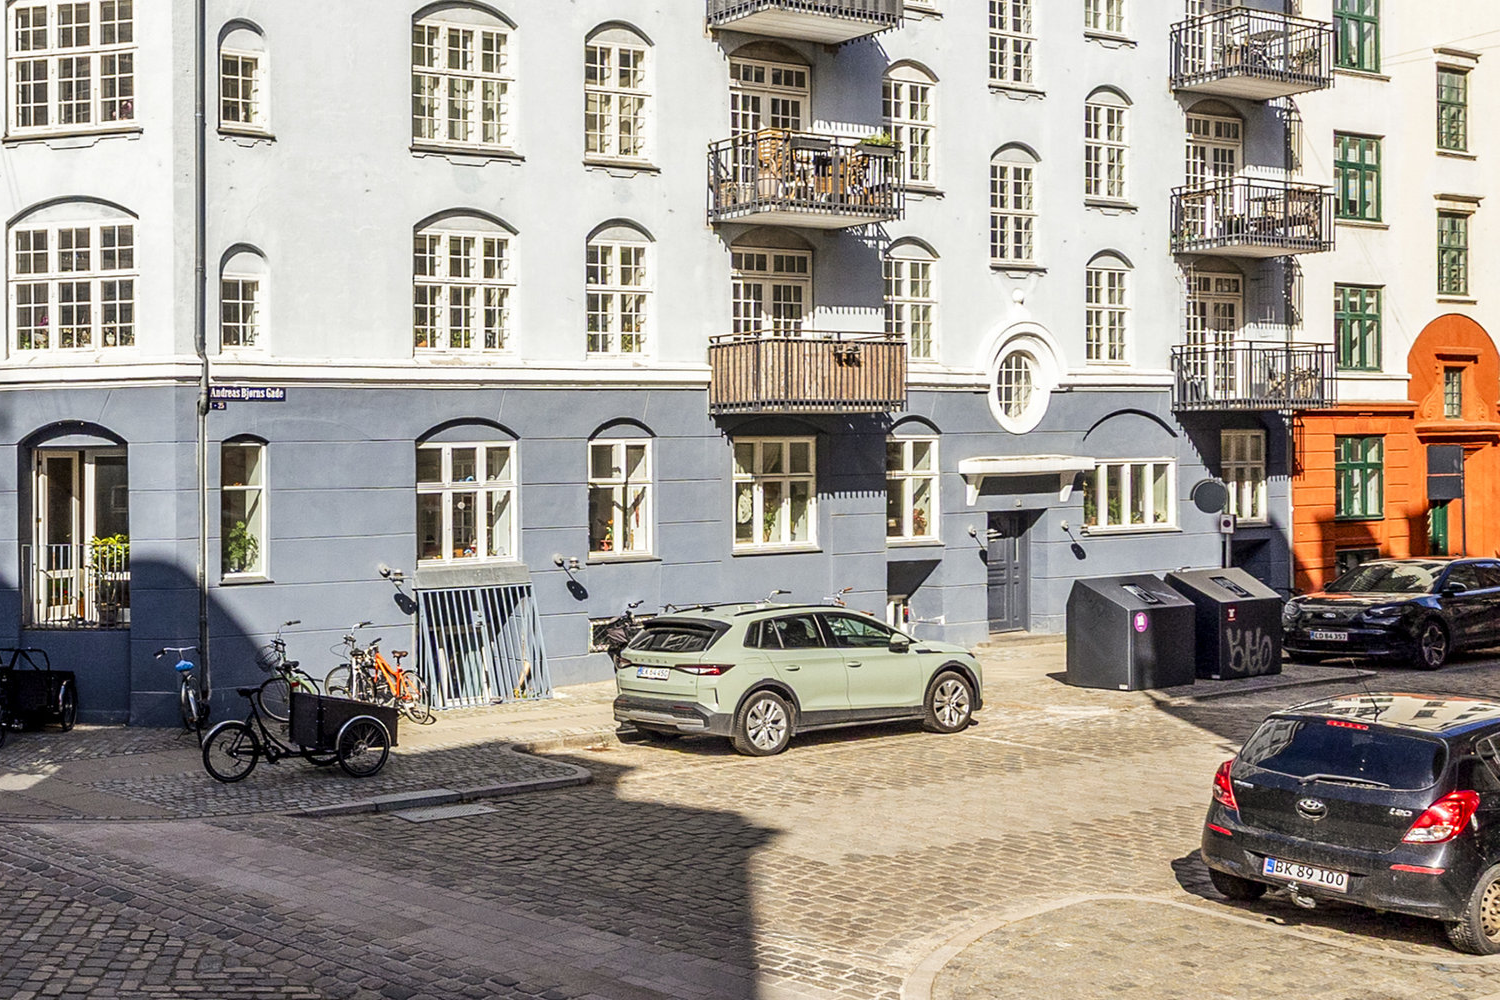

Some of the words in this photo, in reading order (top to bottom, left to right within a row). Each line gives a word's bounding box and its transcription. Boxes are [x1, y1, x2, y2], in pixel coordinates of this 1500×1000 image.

[209, 387, 240, 398] Andreas
[265, 387, 284, 398] Gade
[1275, 860, 1293, 876] BK
[1296, 865, 1314, 880] 89
[1317, 869, 1345, 886] 100
